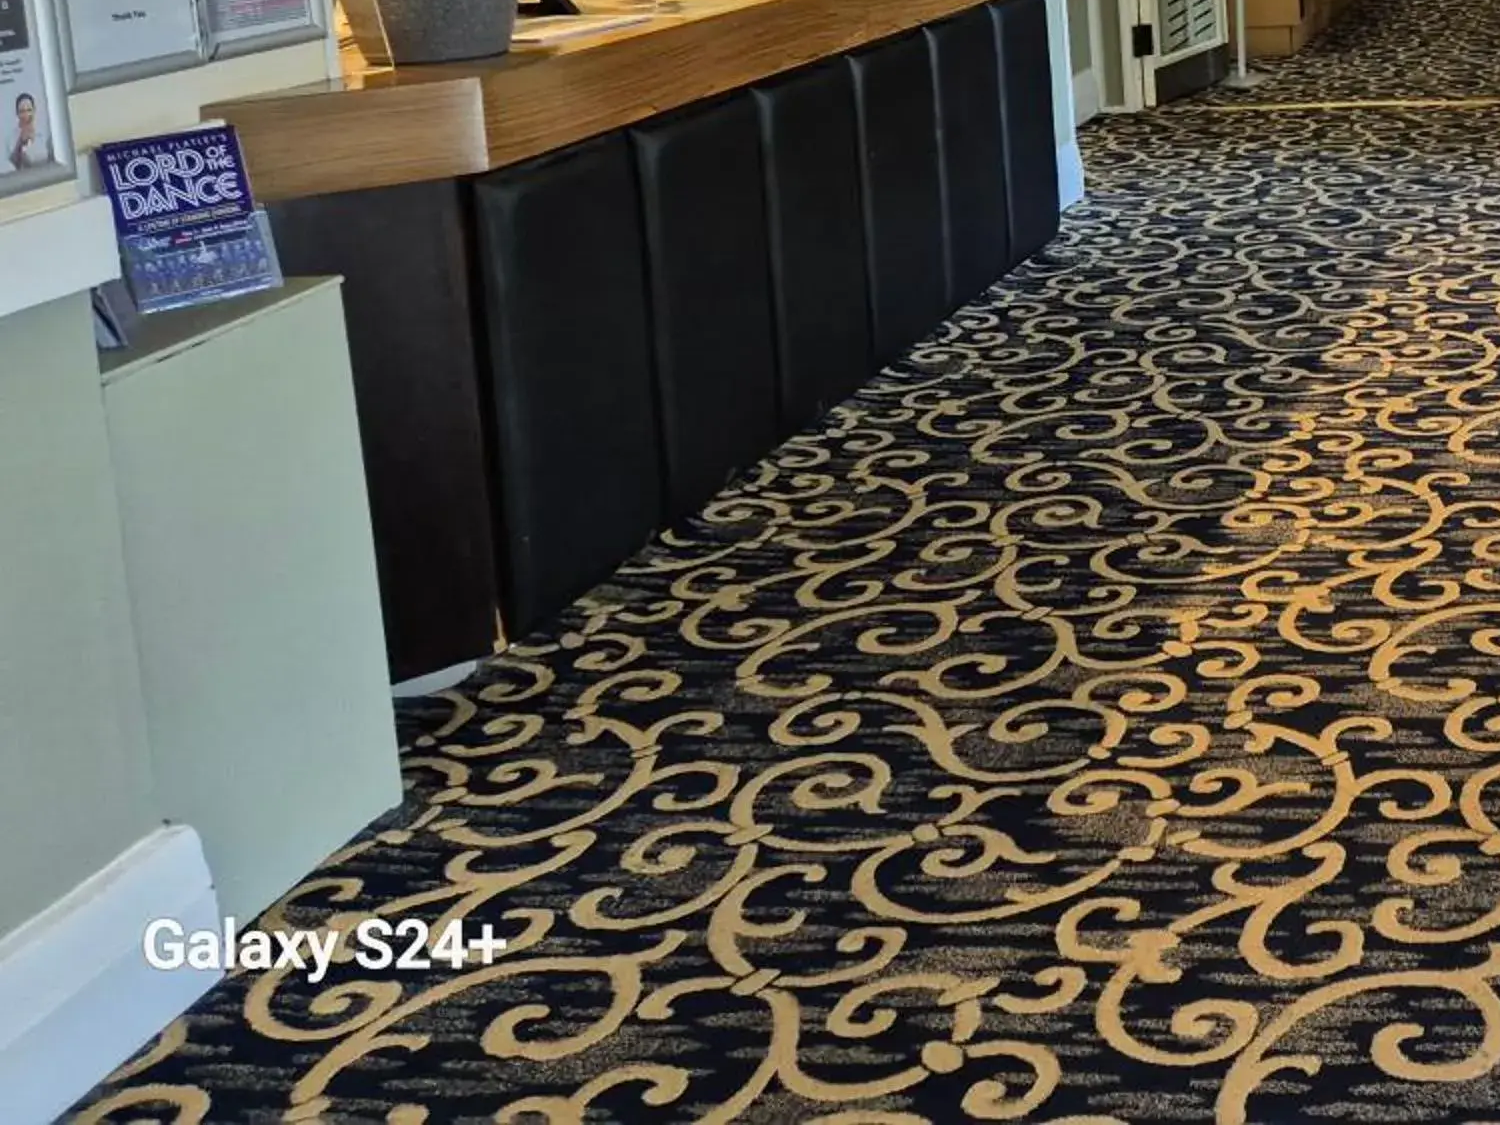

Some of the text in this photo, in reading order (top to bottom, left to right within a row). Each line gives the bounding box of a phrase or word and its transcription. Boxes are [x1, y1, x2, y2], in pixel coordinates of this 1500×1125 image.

[107, 133, 227, 162] MICHAEL FLATLEY'S
[206, 154, 236, 171] THE
[109, 145, 228, 191] LORD OF
[118, 172, 243, 220] DANCE
